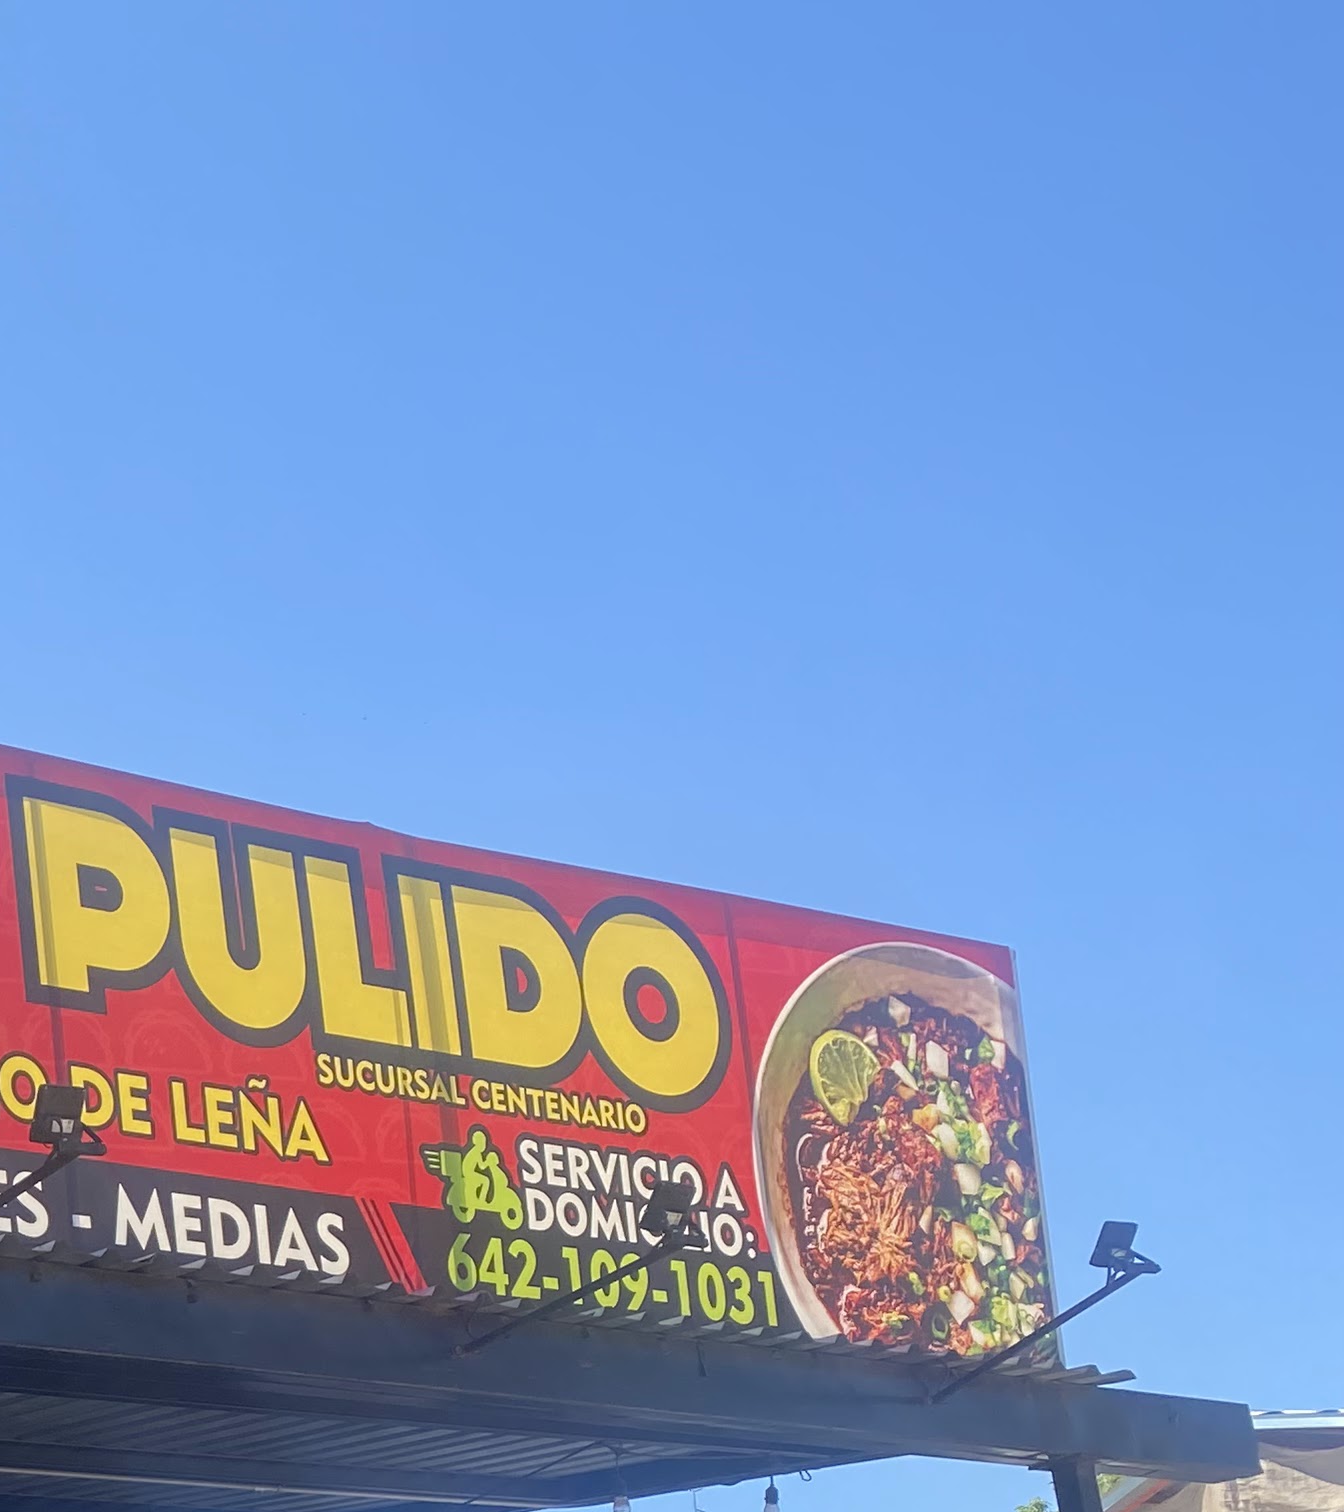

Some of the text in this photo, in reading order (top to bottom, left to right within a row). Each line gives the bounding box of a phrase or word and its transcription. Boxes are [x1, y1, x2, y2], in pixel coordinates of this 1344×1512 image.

[23, 796, 721, 1098] PULIDO
[70, 1065, 152, 1136] DE
[171, 1076, 329, 1164] LEÑA
[318, 1054, 647, 1134] SUCURSAL CENTENARIO
[72, 1214, 92, 1229] -
[115, 1183, 352, 1276] MEDIAS
[715, 1169, 745, 1212] A
[447, 1233, 779, 1328] 642-109-1031
